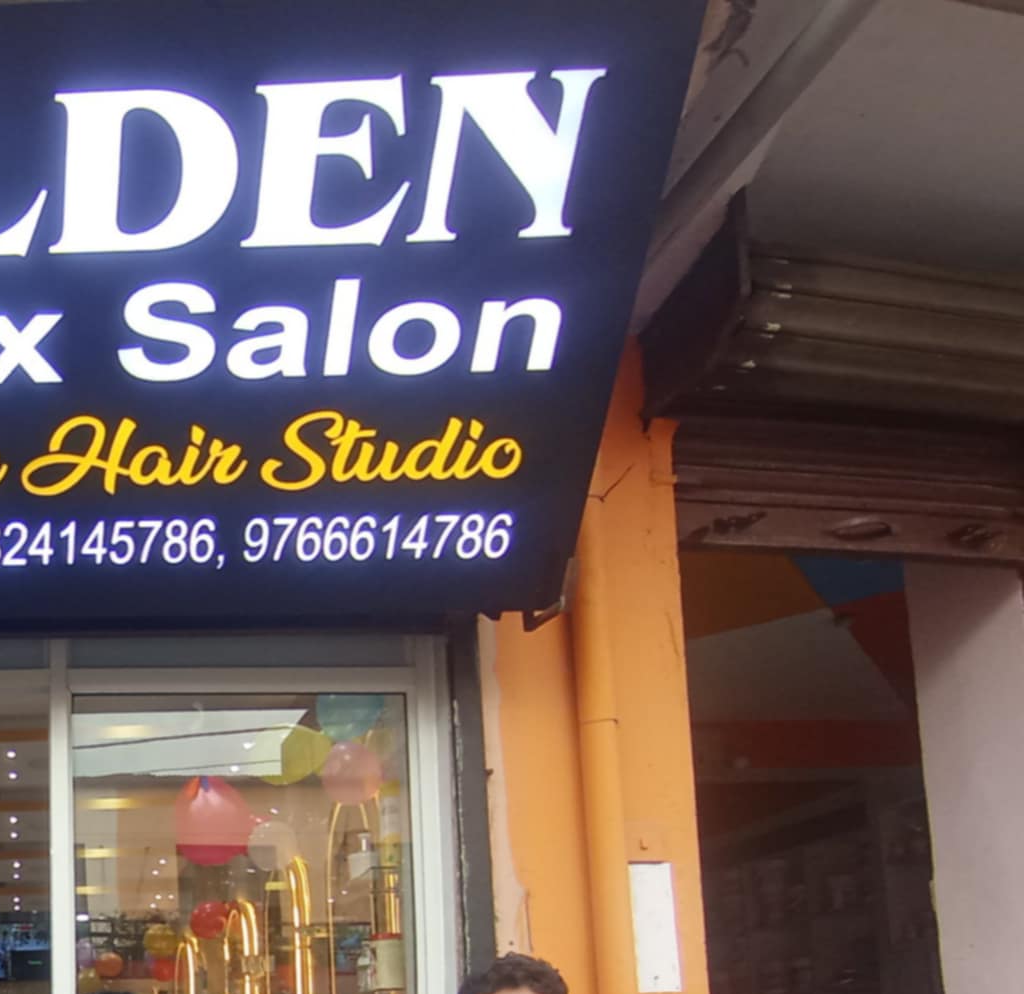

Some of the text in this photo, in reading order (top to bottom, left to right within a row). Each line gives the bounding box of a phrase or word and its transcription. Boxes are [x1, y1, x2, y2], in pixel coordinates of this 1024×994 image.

[119, 278, 562, 381] Salon
[20, 414, 249, 497] Hair
[260, 409, 523, 491] Studio
[243, 513, 513, 562] 9766614786
